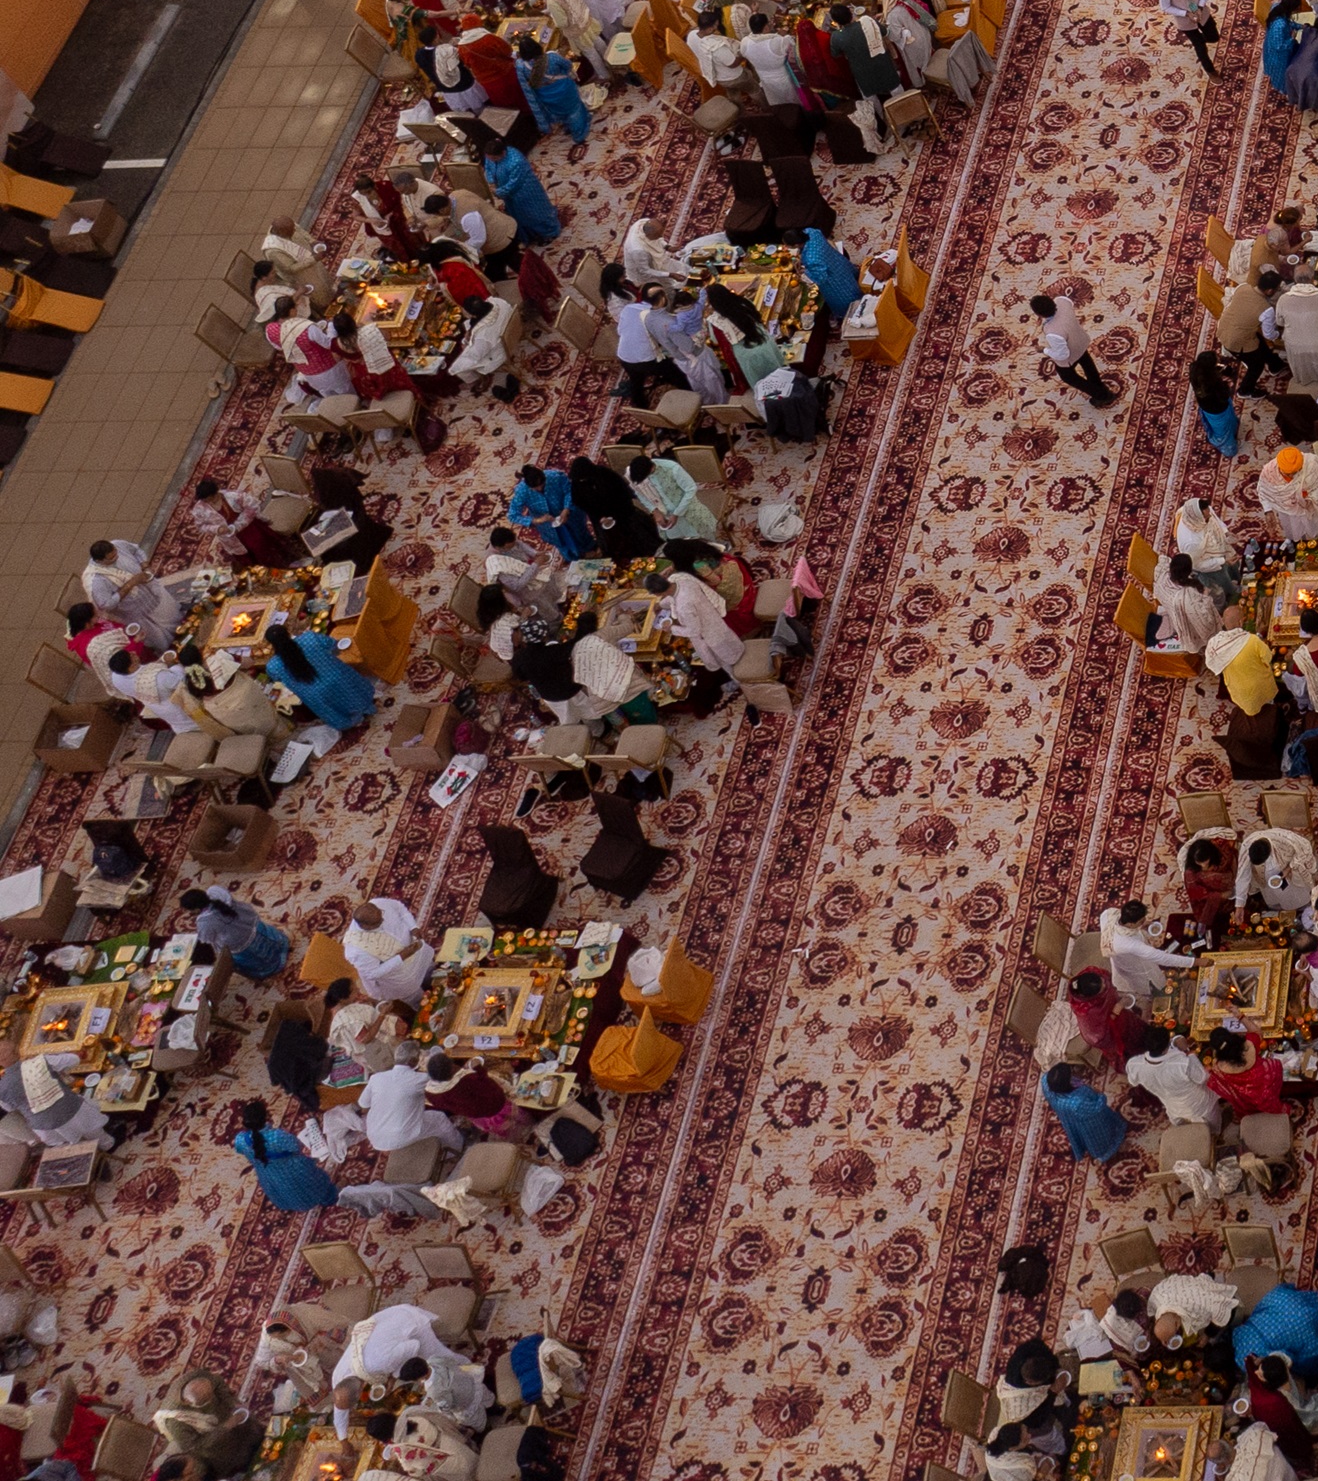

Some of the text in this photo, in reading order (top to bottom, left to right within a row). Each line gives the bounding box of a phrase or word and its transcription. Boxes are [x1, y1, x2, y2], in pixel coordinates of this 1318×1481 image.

[184, 989, 196, 1003] UAE
[526, 1001, 535, 1013] F2
[92, 1016, 102, 1027] F1
[1229, 1020, 1241, 1029] F3
